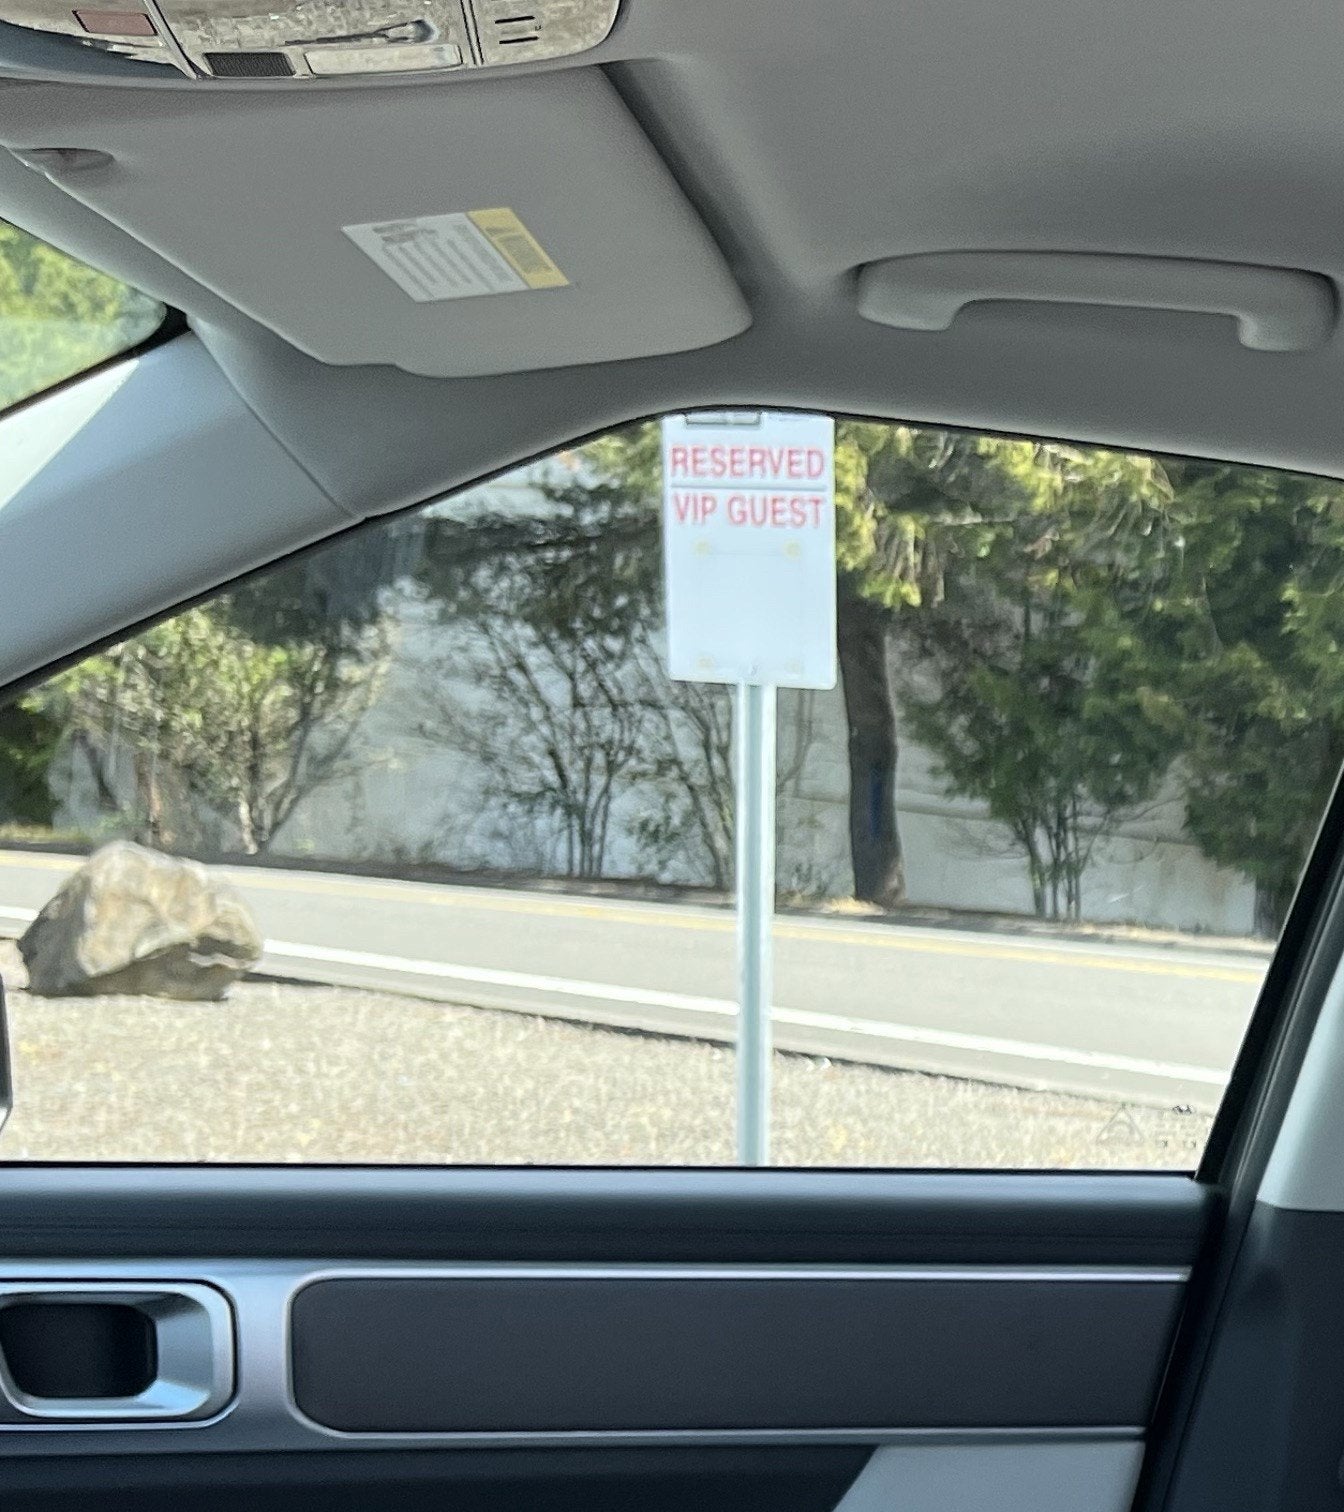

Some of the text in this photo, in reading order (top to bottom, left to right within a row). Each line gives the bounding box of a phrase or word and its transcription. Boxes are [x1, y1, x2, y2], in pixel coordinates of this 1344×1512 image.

[671, 446, 825, 479] RESERVED
[673, 494, 823, 528] VIP GUEST
